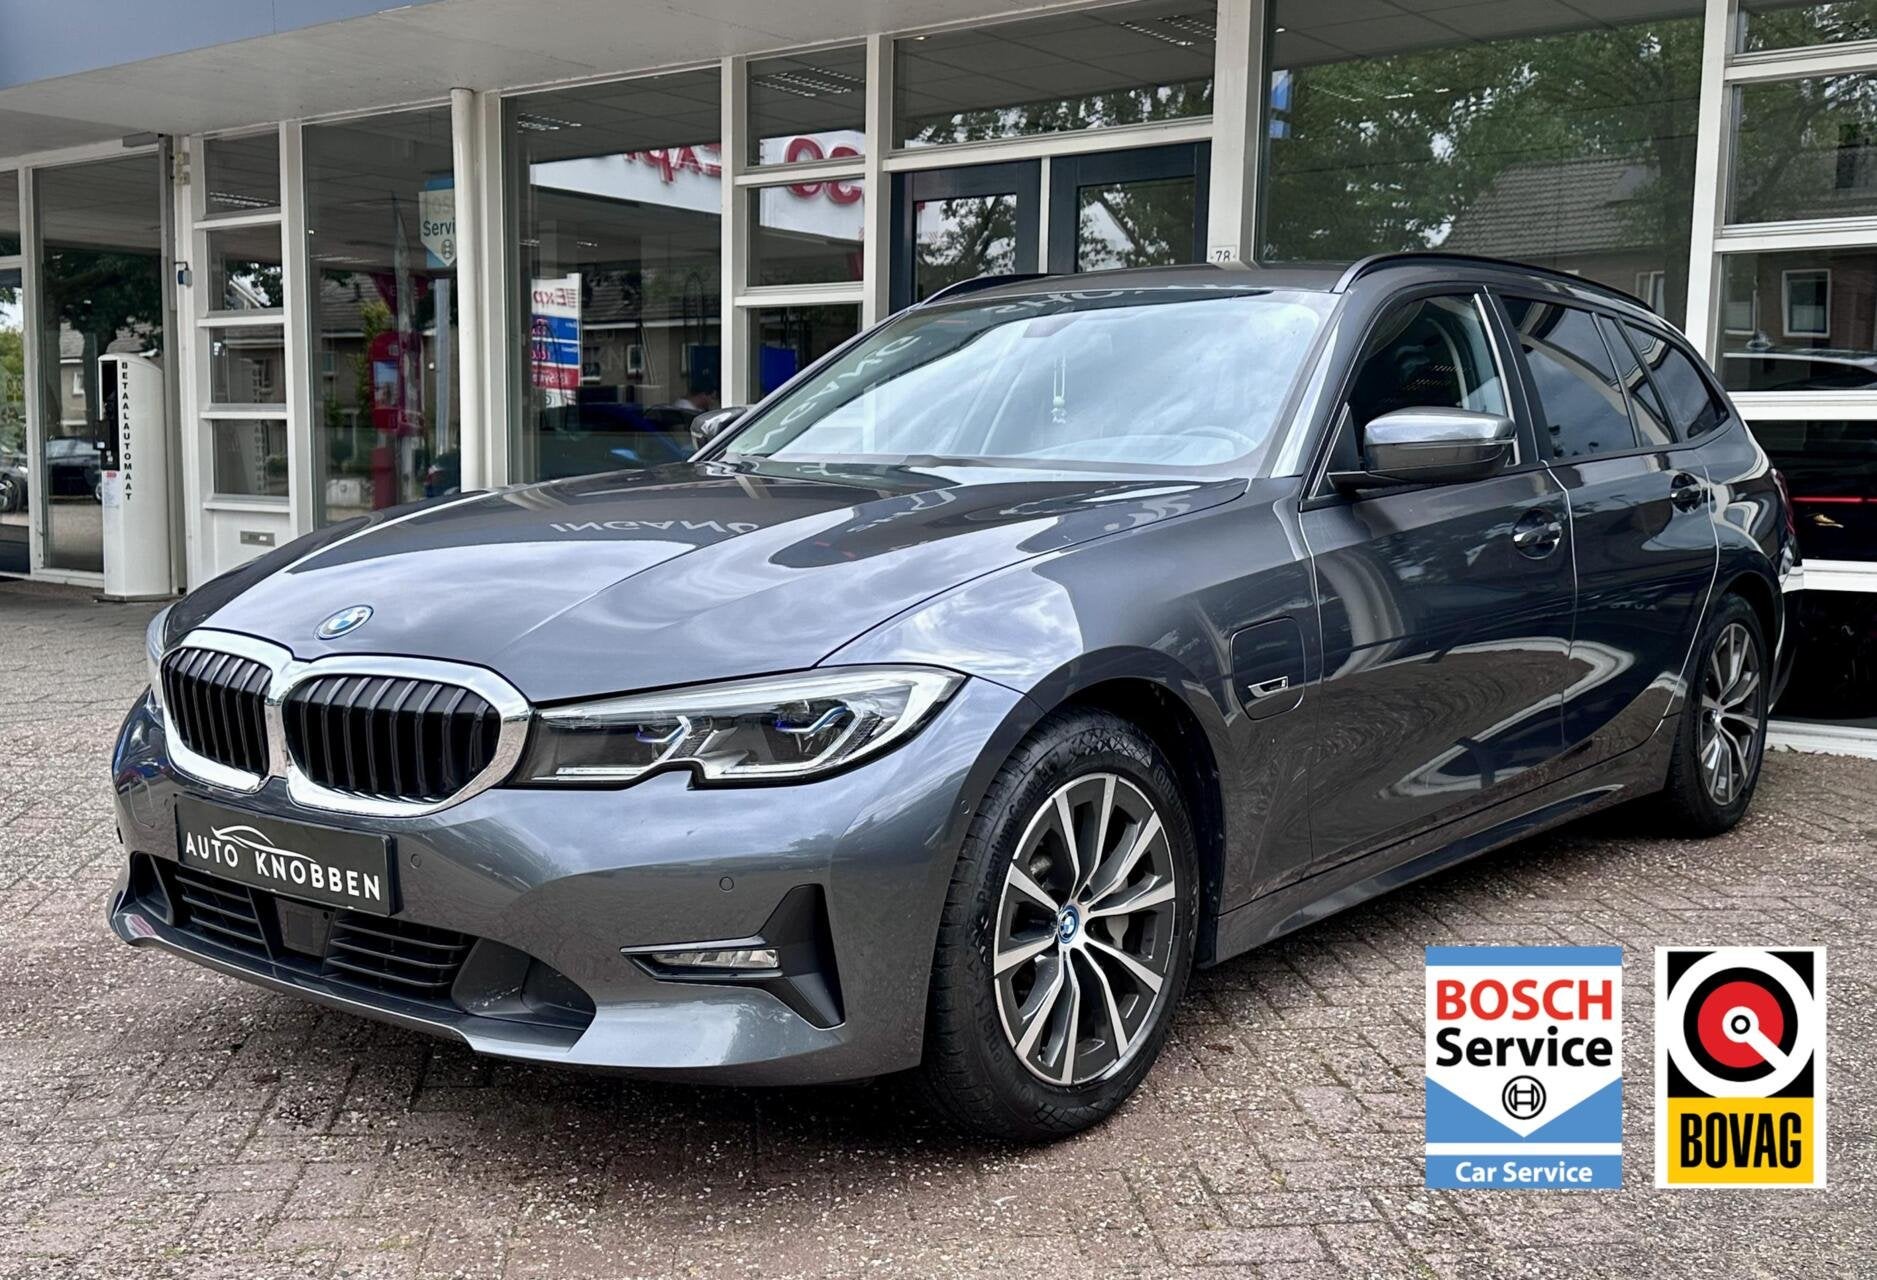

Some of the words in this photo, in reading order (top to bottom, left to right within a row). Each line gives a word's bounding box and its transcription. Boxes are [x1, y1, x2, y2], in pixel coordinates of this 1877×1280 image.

[1215, 250, 1231, 262] 78
[121, 361, 132, 501] BETAALAUTOMAAT
[186, 831, 239, 869] AUTO
[255, 850, 380, 901] KNOBBEN
